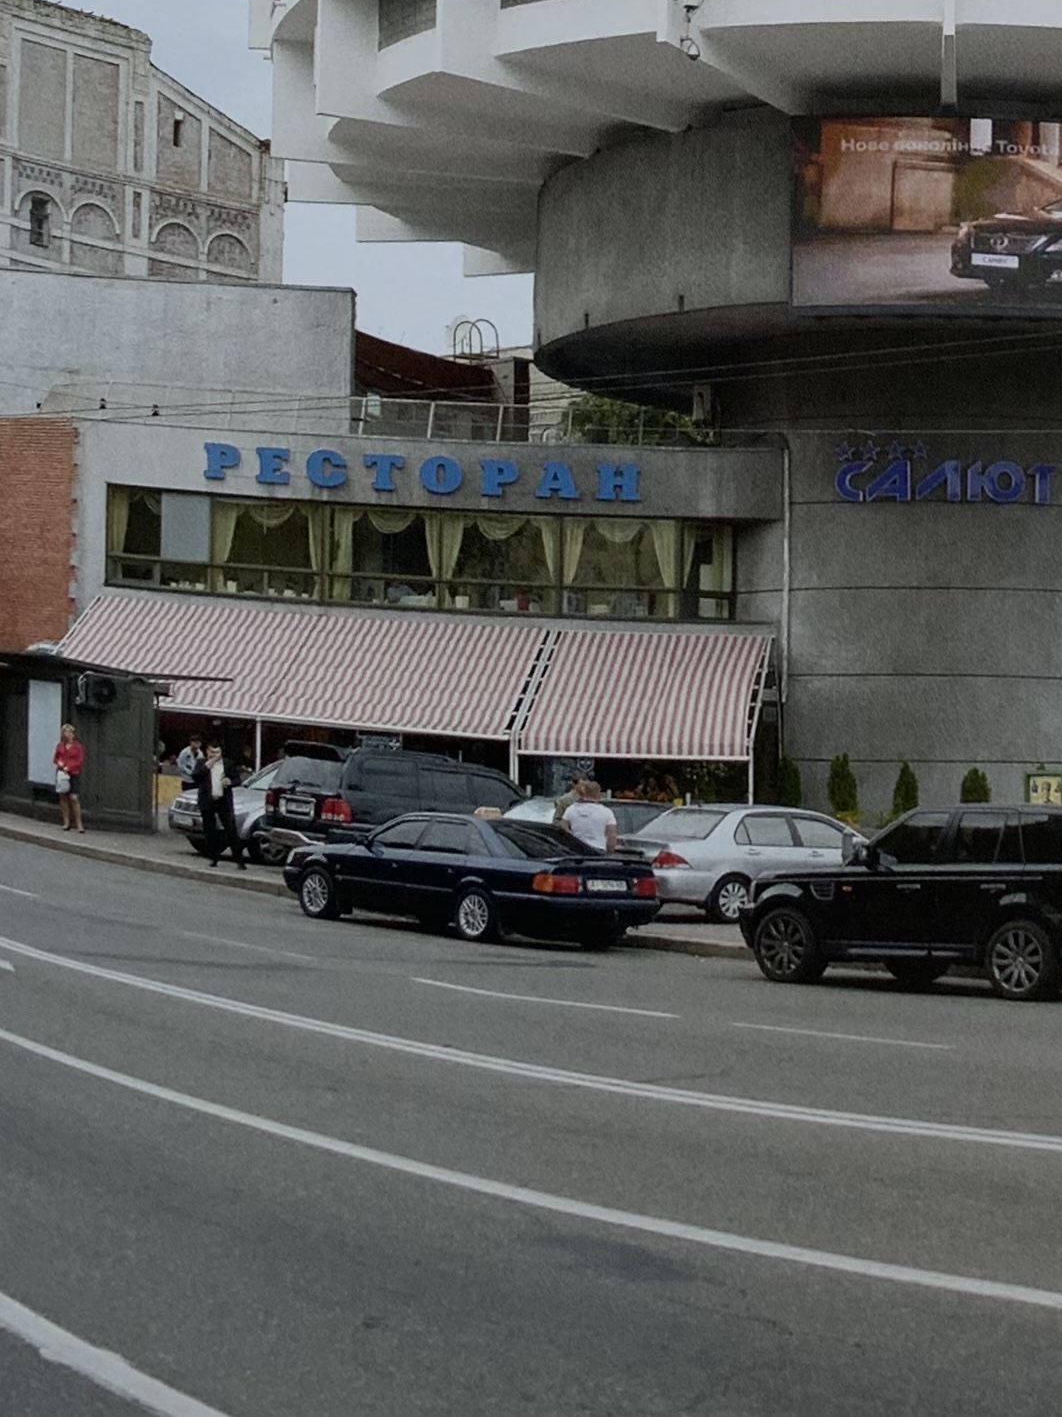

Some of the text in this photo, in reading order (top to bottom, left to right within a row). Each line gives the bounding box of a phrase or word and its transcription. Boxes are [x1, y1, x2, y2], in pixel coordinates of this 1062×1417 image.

[840, 139, 889, 152] Нове
[893, 138, 992, 155] поколін
[203, 442, 642, 502] РЕСТОРАН
[834, 460, 1057, 503] САЛЮТ
